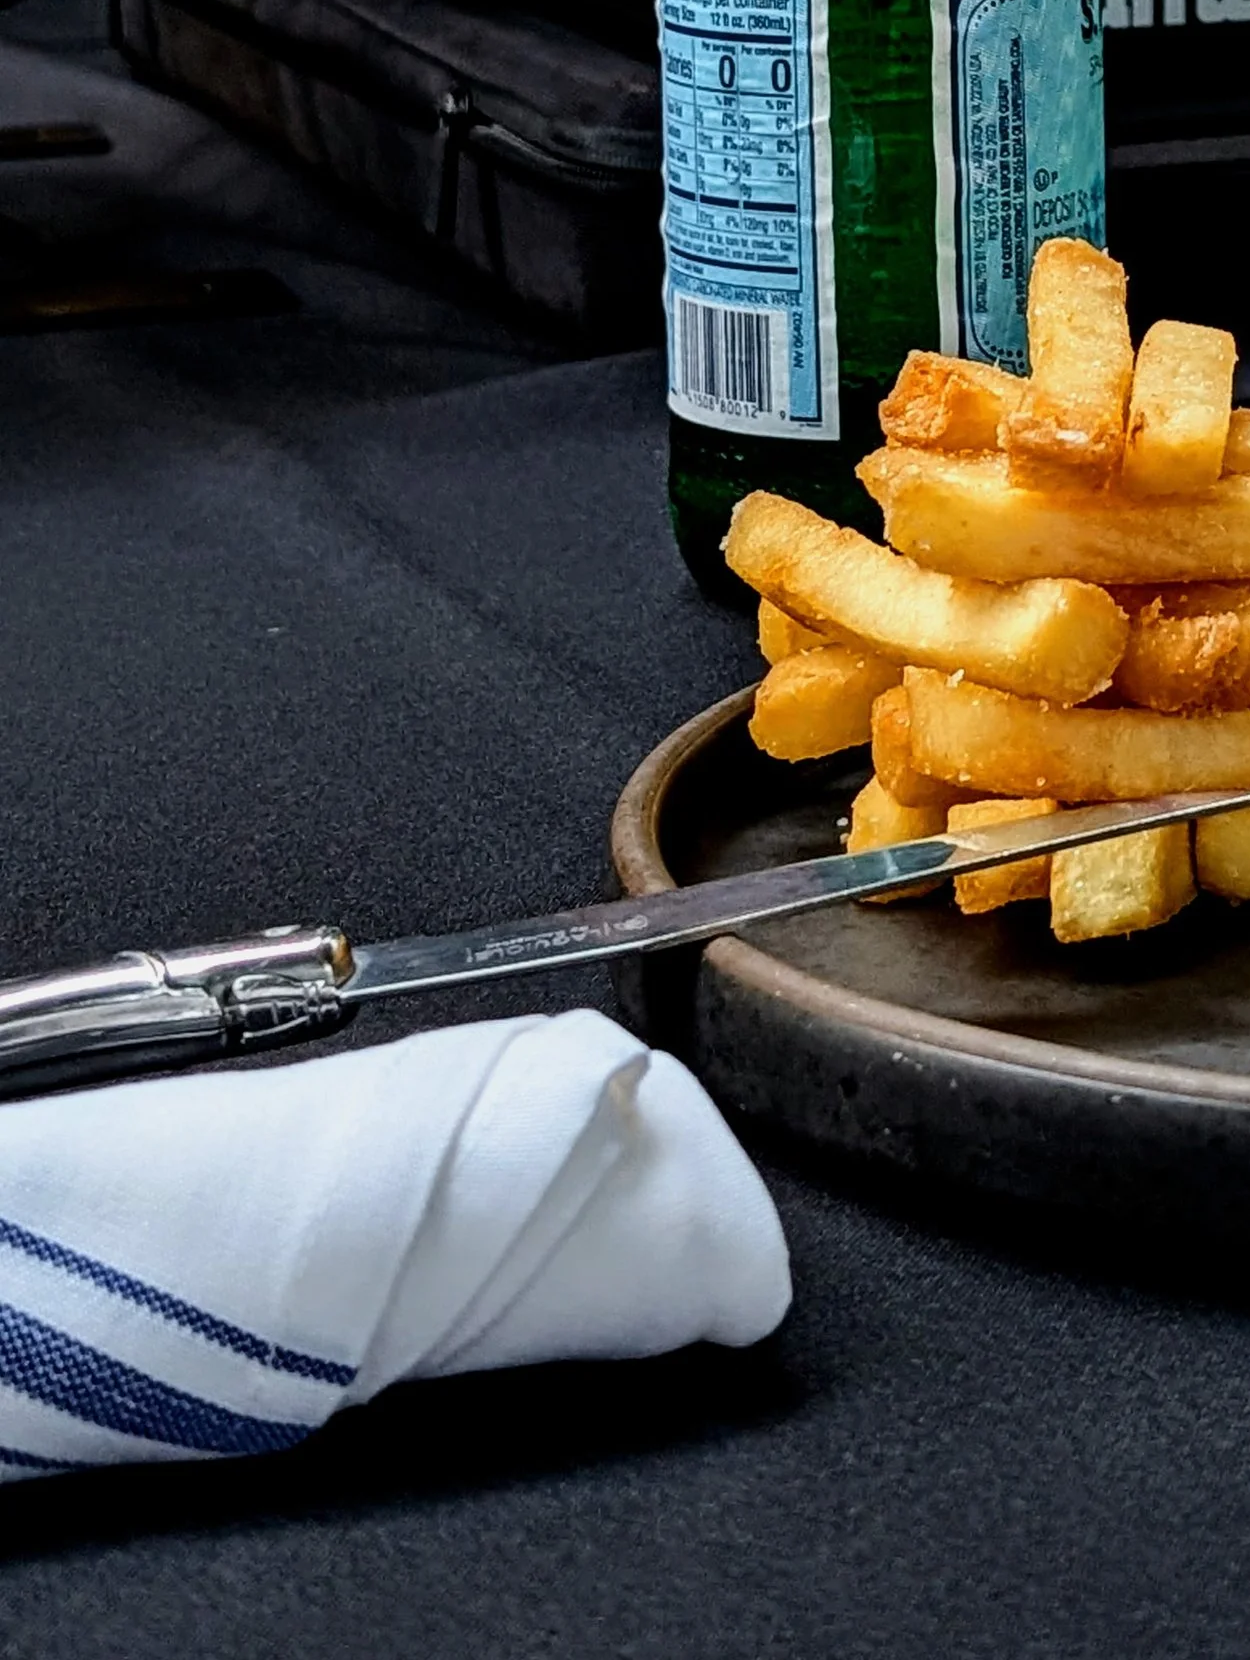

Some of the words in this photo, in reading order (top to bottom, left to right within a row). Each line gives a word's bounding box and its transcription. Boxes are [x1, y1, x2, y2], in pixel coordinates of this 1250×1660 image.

[718, 54, 736, 89] 0
[771, 58, 791, 93] 0
[773, 219, 796, 233] 10%
[720, 401, 758, 420] 80012
[779, 410, 787, 422] 9
